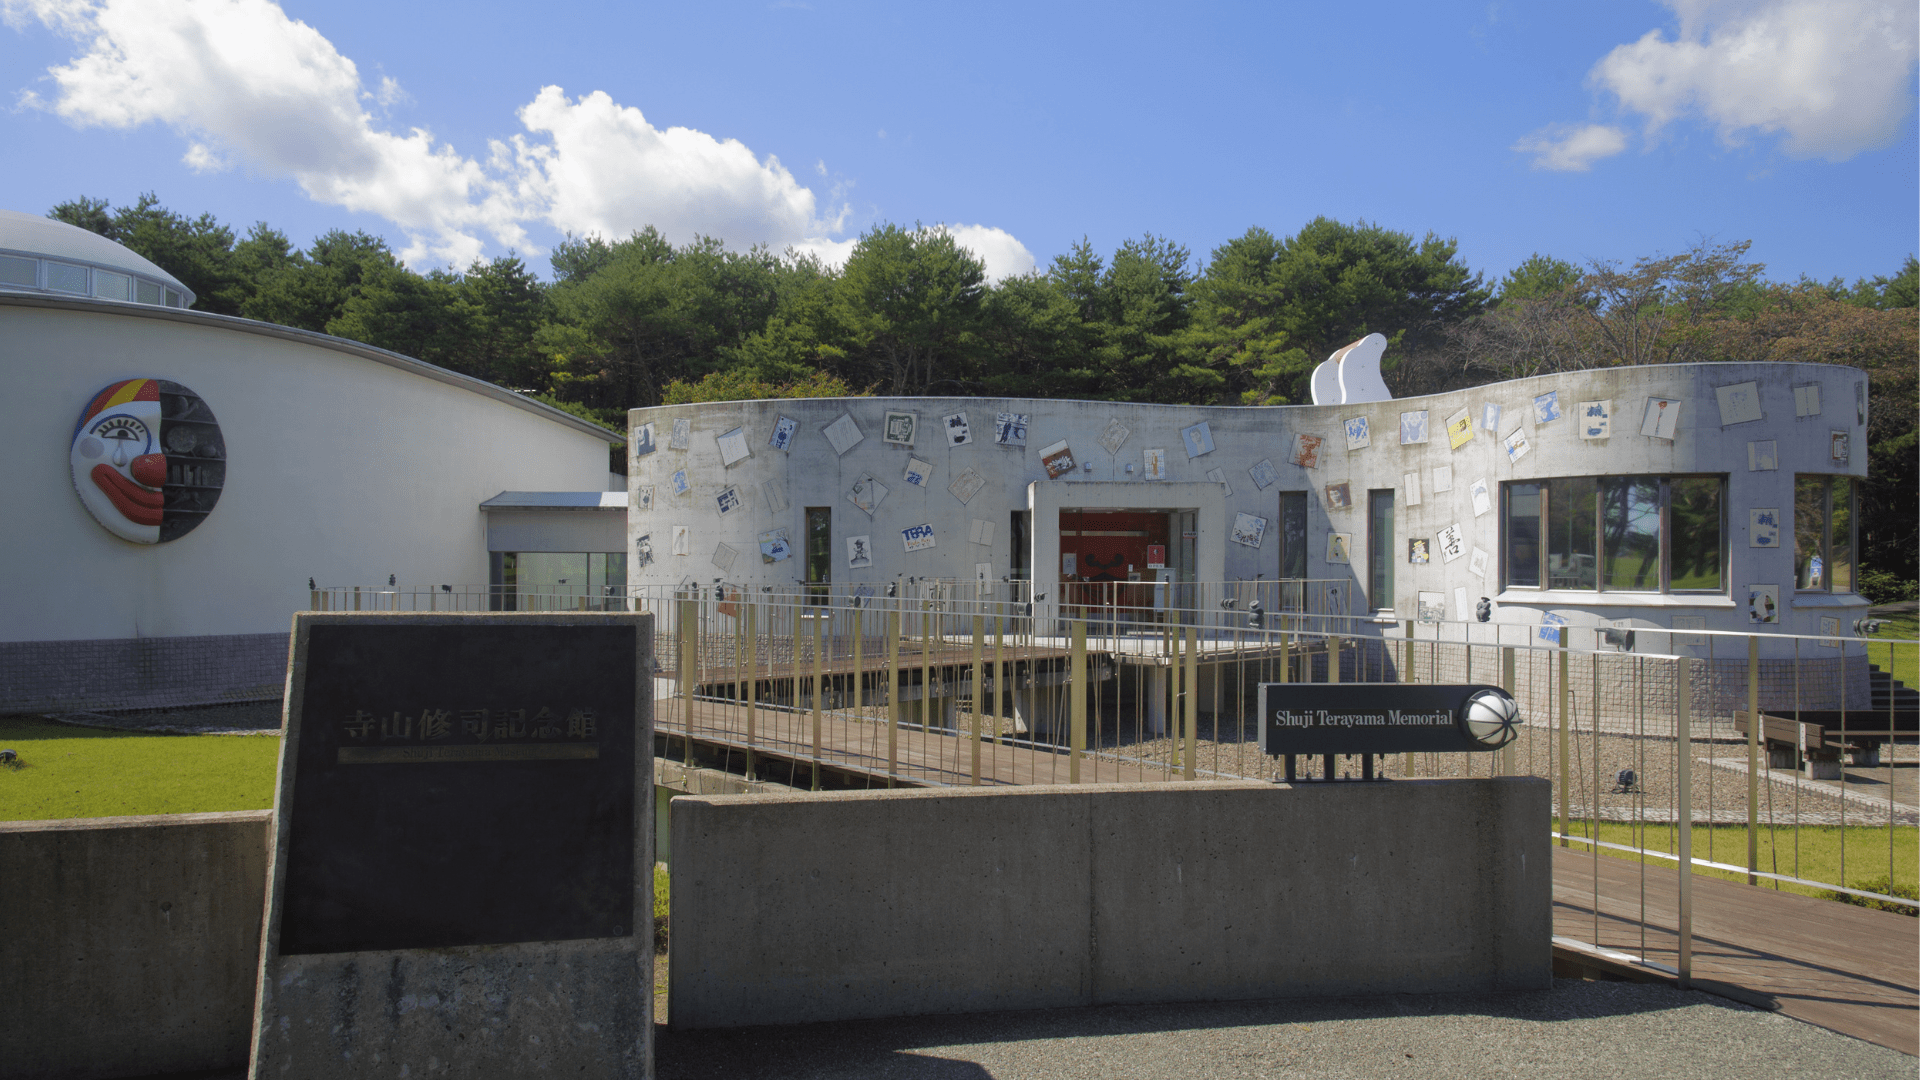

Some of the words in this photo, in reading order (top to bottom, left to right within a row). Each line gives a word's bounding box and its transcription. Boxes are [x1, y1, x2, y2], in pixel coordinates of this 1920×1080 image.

[343, 706, 599, 741] 寺山修司記念館
[1275, 709, 1314, 729] Shuji
[1316, 709, 1385, 729] Terayama
[1387, 709, 1453, 726] Memorial
[403, 746, 433, 760] Shuji
[436, 745, 491, 759] Terayama
